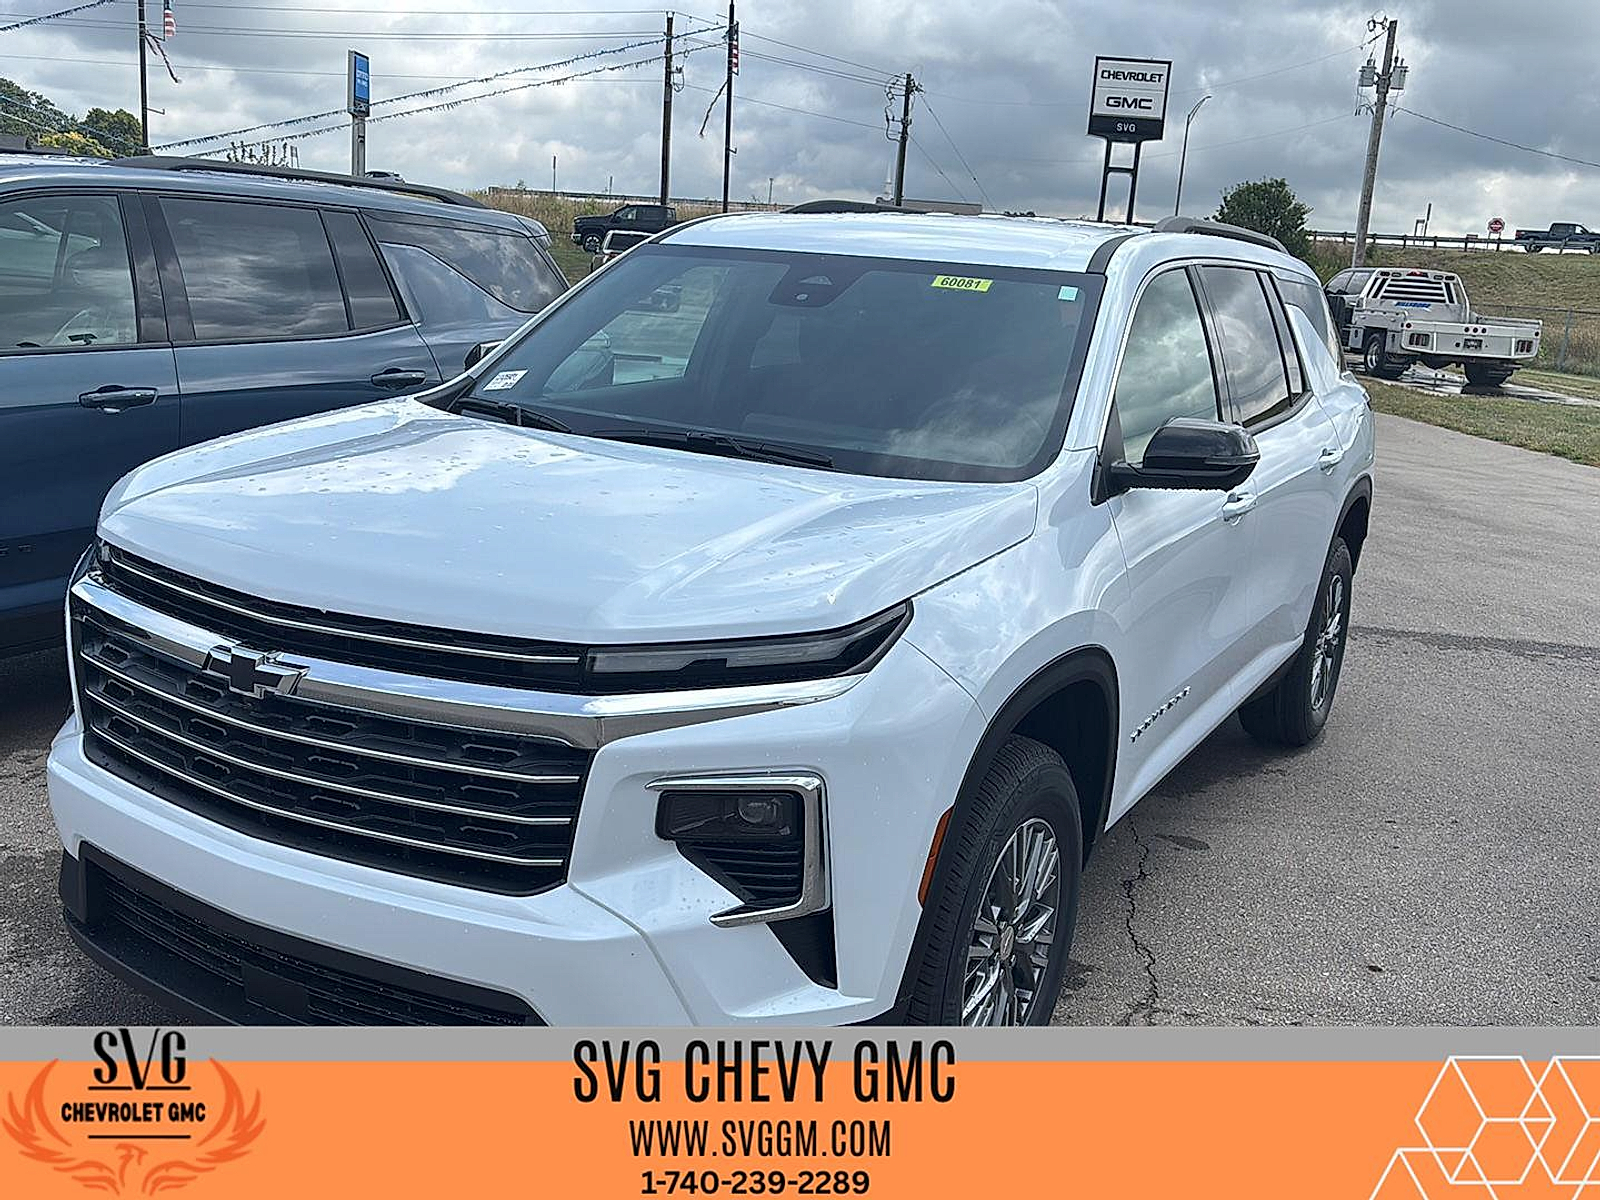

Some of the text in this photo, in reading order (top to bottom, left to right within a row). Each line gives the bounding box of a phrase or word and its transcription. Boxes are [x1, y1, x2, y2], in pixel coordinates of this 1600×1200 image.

[1100, 69, 1164, 83] CHEVROLET
[1105, 96, 1153, 110] GMC
[1116, 123, 1136, 133] SVG
[940, 277, 982, 289] 60081
